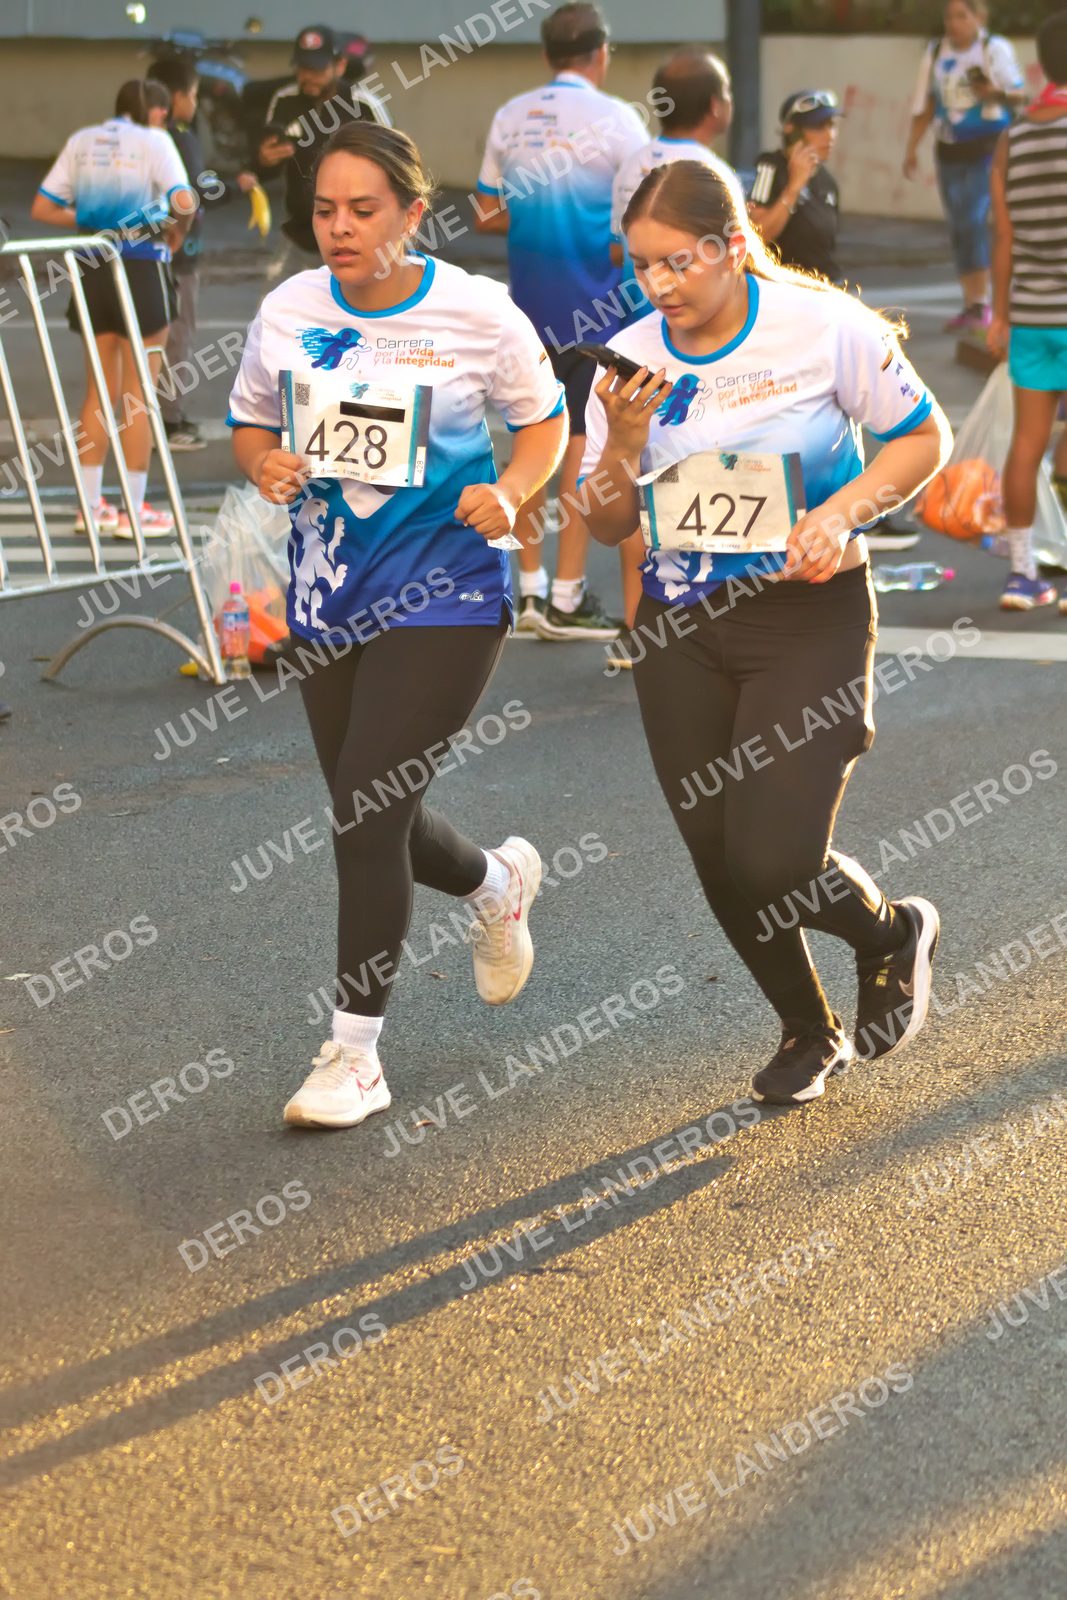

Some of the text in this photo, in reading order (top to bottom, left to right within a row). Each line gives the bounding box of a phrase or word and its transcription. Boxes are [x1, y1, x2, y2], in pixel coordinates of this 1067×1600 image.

[376, 337, 434, 350] Carrera
[374, 350, 394, 359] por
[394, 356, 455, 368] Integridad
[715, 368, 772, 389] Carrera
[717, 388, 735, 401] por
[304, 418, 388, 470] 428
[676, 491, 768, 538] 427
